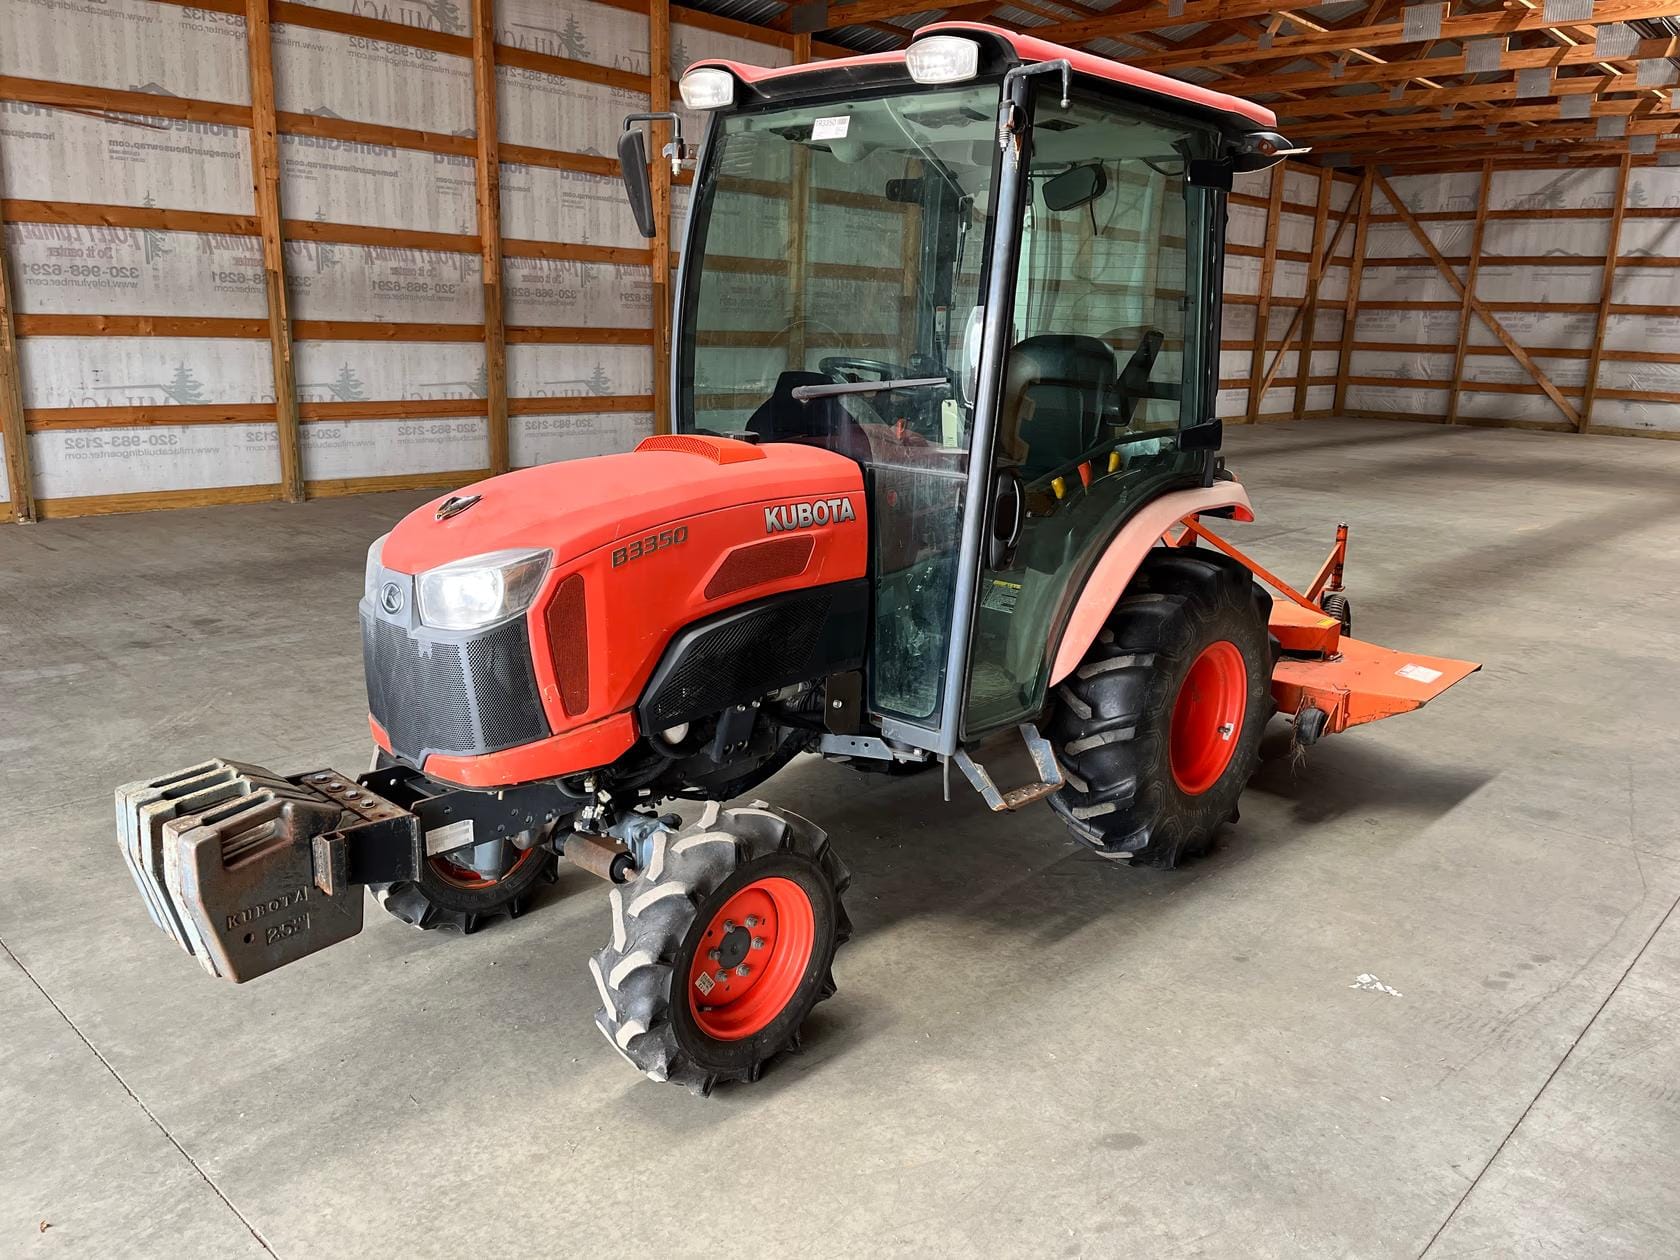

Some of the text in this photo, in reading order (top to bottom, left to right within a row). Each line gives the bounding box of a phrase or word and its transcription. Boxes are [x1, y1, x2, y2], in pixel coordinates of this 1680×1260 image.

[764, 497, 857, 533] KUBOTA
[611, 525, 689, 569] B3350
[227, 885, 309, 930] KUBOTA
